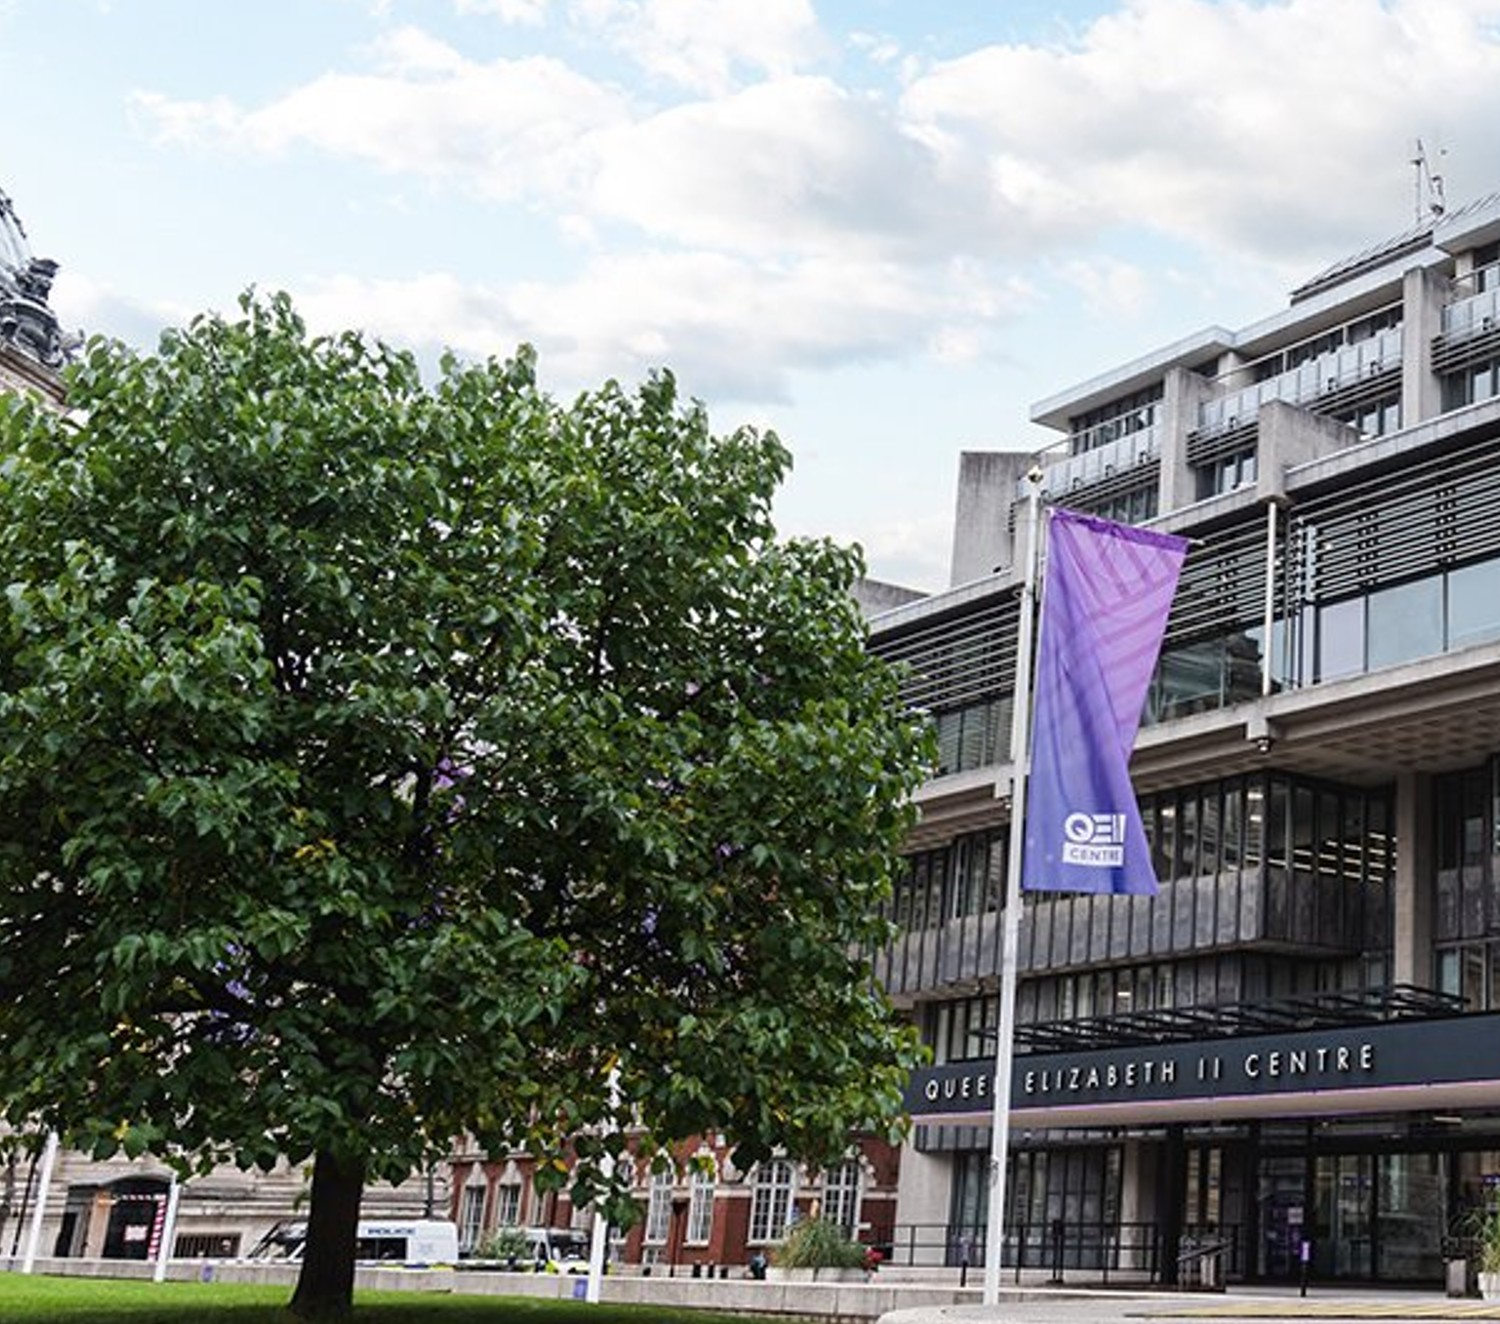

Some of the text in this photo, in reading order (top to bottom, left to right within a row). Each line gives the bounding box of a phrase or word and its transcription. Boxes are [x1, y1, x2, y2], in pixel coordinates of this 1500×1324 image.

[1070, 847, 1120, 862] CENTRE
[925, 1043, 1373, 1101] QUEE ELIZABETH II CENTRE
[367, 1227, 417, 1237] POLICE
